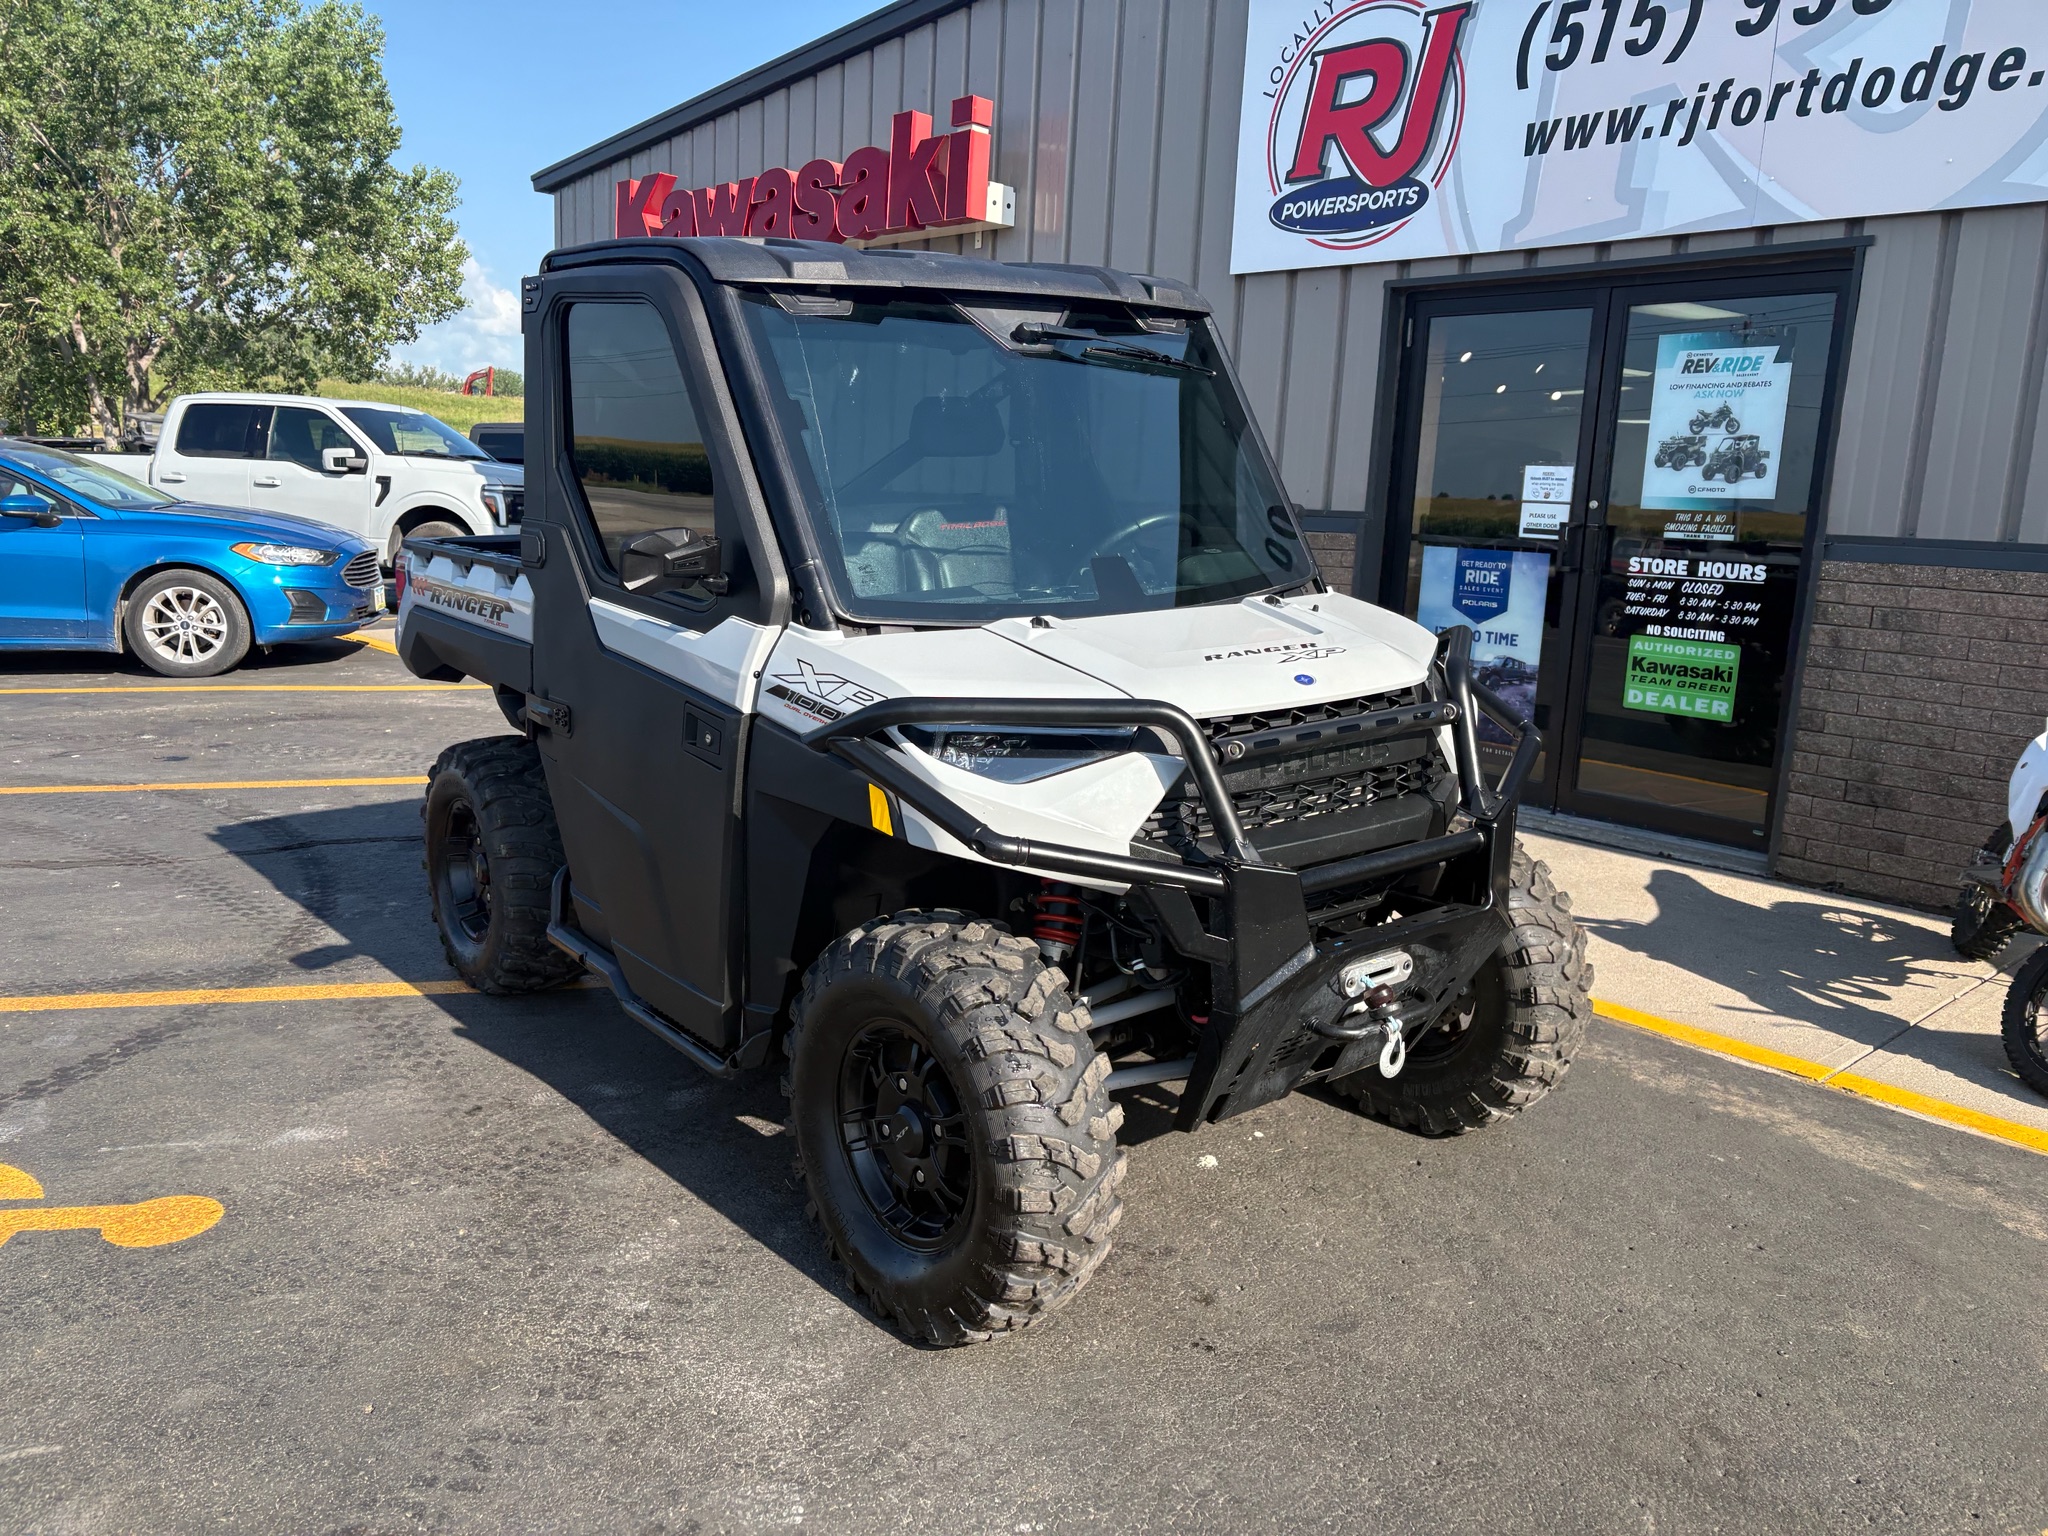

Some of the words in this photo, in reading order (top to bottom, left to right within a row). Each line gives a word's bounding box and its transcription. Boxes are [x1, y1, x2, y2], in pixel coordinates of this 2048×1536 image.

[1516, 0, 1703, 90] (515)
[1284, 1, 1473, 187] RJ
[615, 94, 993, 243] Kawasaki
[1281, 186, 1420, 220] POWERSPORTS
[1685, 382, 1725, 390] FINANCING
[1743, 380, 1773, 388] REBATES
[1694, 390, 1714, 399] ASK
[1716, 389, 1745, 399] NOW
[1664, 522, 1698, 531] SMOKING
[1701, 524, 1735, 533] FACILITY
[1675, 513, 1691, 521] THIS
[1694, 513, 1702, 522] IS
[1705, 514, 1712, 522] A
[1714, 515, 1726, 523] NO
[1465, 569, 1500, 586] RIDE
[1628, 557, 1688, 575] STORE
[1698, 561, 1767, 581] HOURS
[1627, 578, 1646, 588] SUN
[1652, 581, 1675, 590] MON
[1681, 581, 1724, 596] CLOSED
[430, 587, 505, 621] RANGER
[1462, 599, 1498, 608] POLARIS
[1625, 592, 1646, 601] TUES
[1652, 594, 1668, 603] FRI
[1699, 598, 1716, 608] AM
[1743, 602, 1761, 611] PM
[1624, 605, 1670, 617] SATURDAY
[1697, 612, 1715, 622] AM
[1741, 616, 1759, 626] PM
[1485, 631, 1519, 647] TIME
[1646, 624, 1661, 635] NO
[1663, 626, 1725, 642] SOLICITING
[1204, 643, 1318, 661] RANGER
[1277, 647, 1347, 664] XP
[1634, 641, 1735, 660] AUTHORIZED
[1631, 656, 1734, 683] Kawasaki
[770, 658, 888, 706] XP
[1630, 674, 1672, 687] TEAM
[1676, 680, 1731, 694] GREEN
[784, 689, 847, 721] 100
[784, 703, 801, 714] DUAL
[1627, 689, 1729, 717] DEALER
